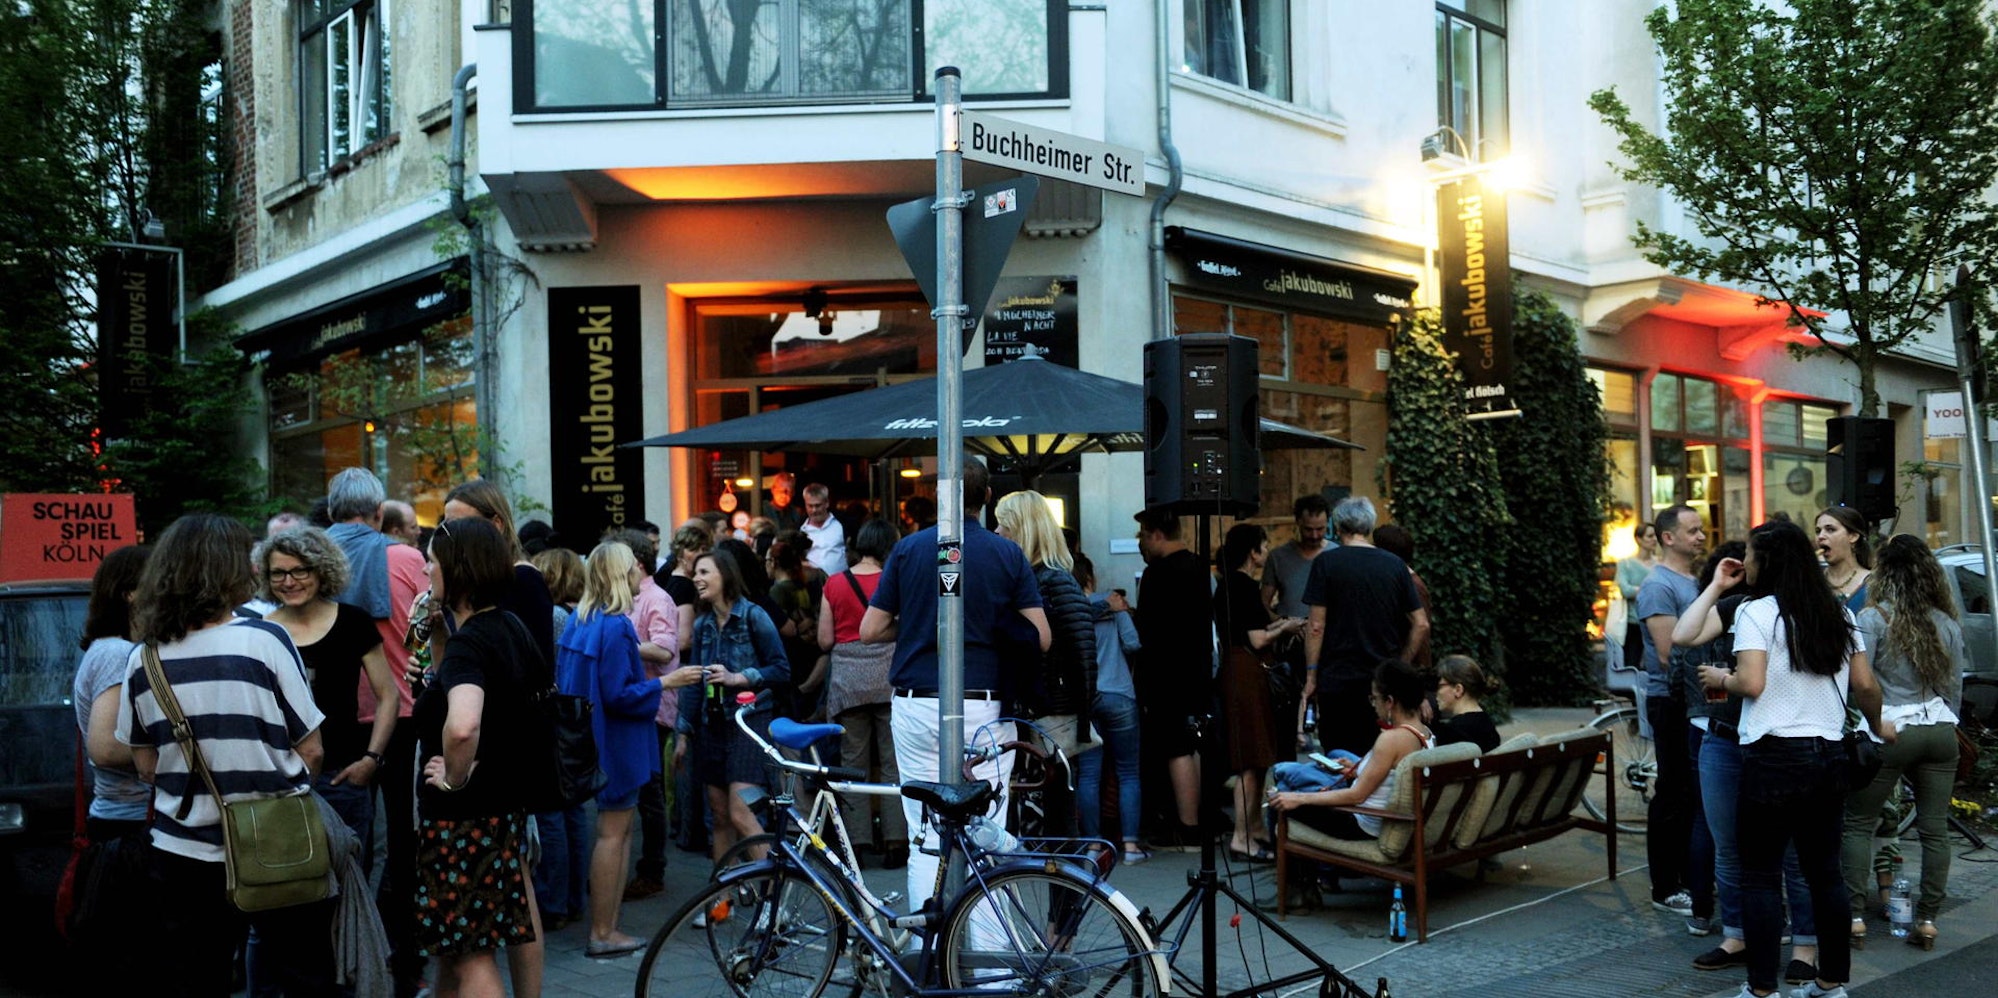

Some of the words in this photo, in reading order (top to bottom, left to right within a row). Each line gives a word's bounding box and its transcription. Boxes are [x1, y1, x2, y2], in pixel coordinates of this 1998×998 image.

[972, 122, 1092, 175] Buchheimer
[1103, 153, 1136, 185] Str.
[1457, 194, 1493, 337] jakubowski
[1263, 278, 1282, 294] Café
[1279, 268, 1354, 300] jakubowski
[122, 271, 152, 394] jakubowski
[1480, 334, 1494, 370] Café
[578, 305, 625, 494] jakubowski
[1933, 408, 1963, 419] YOO
[884, 415, 1010, 430] fritzola
[33, 502, 113, 520] SCHAU
[61, 522, 122, 540] SPIEL
[43, 541, 105, 562] KÖLN
